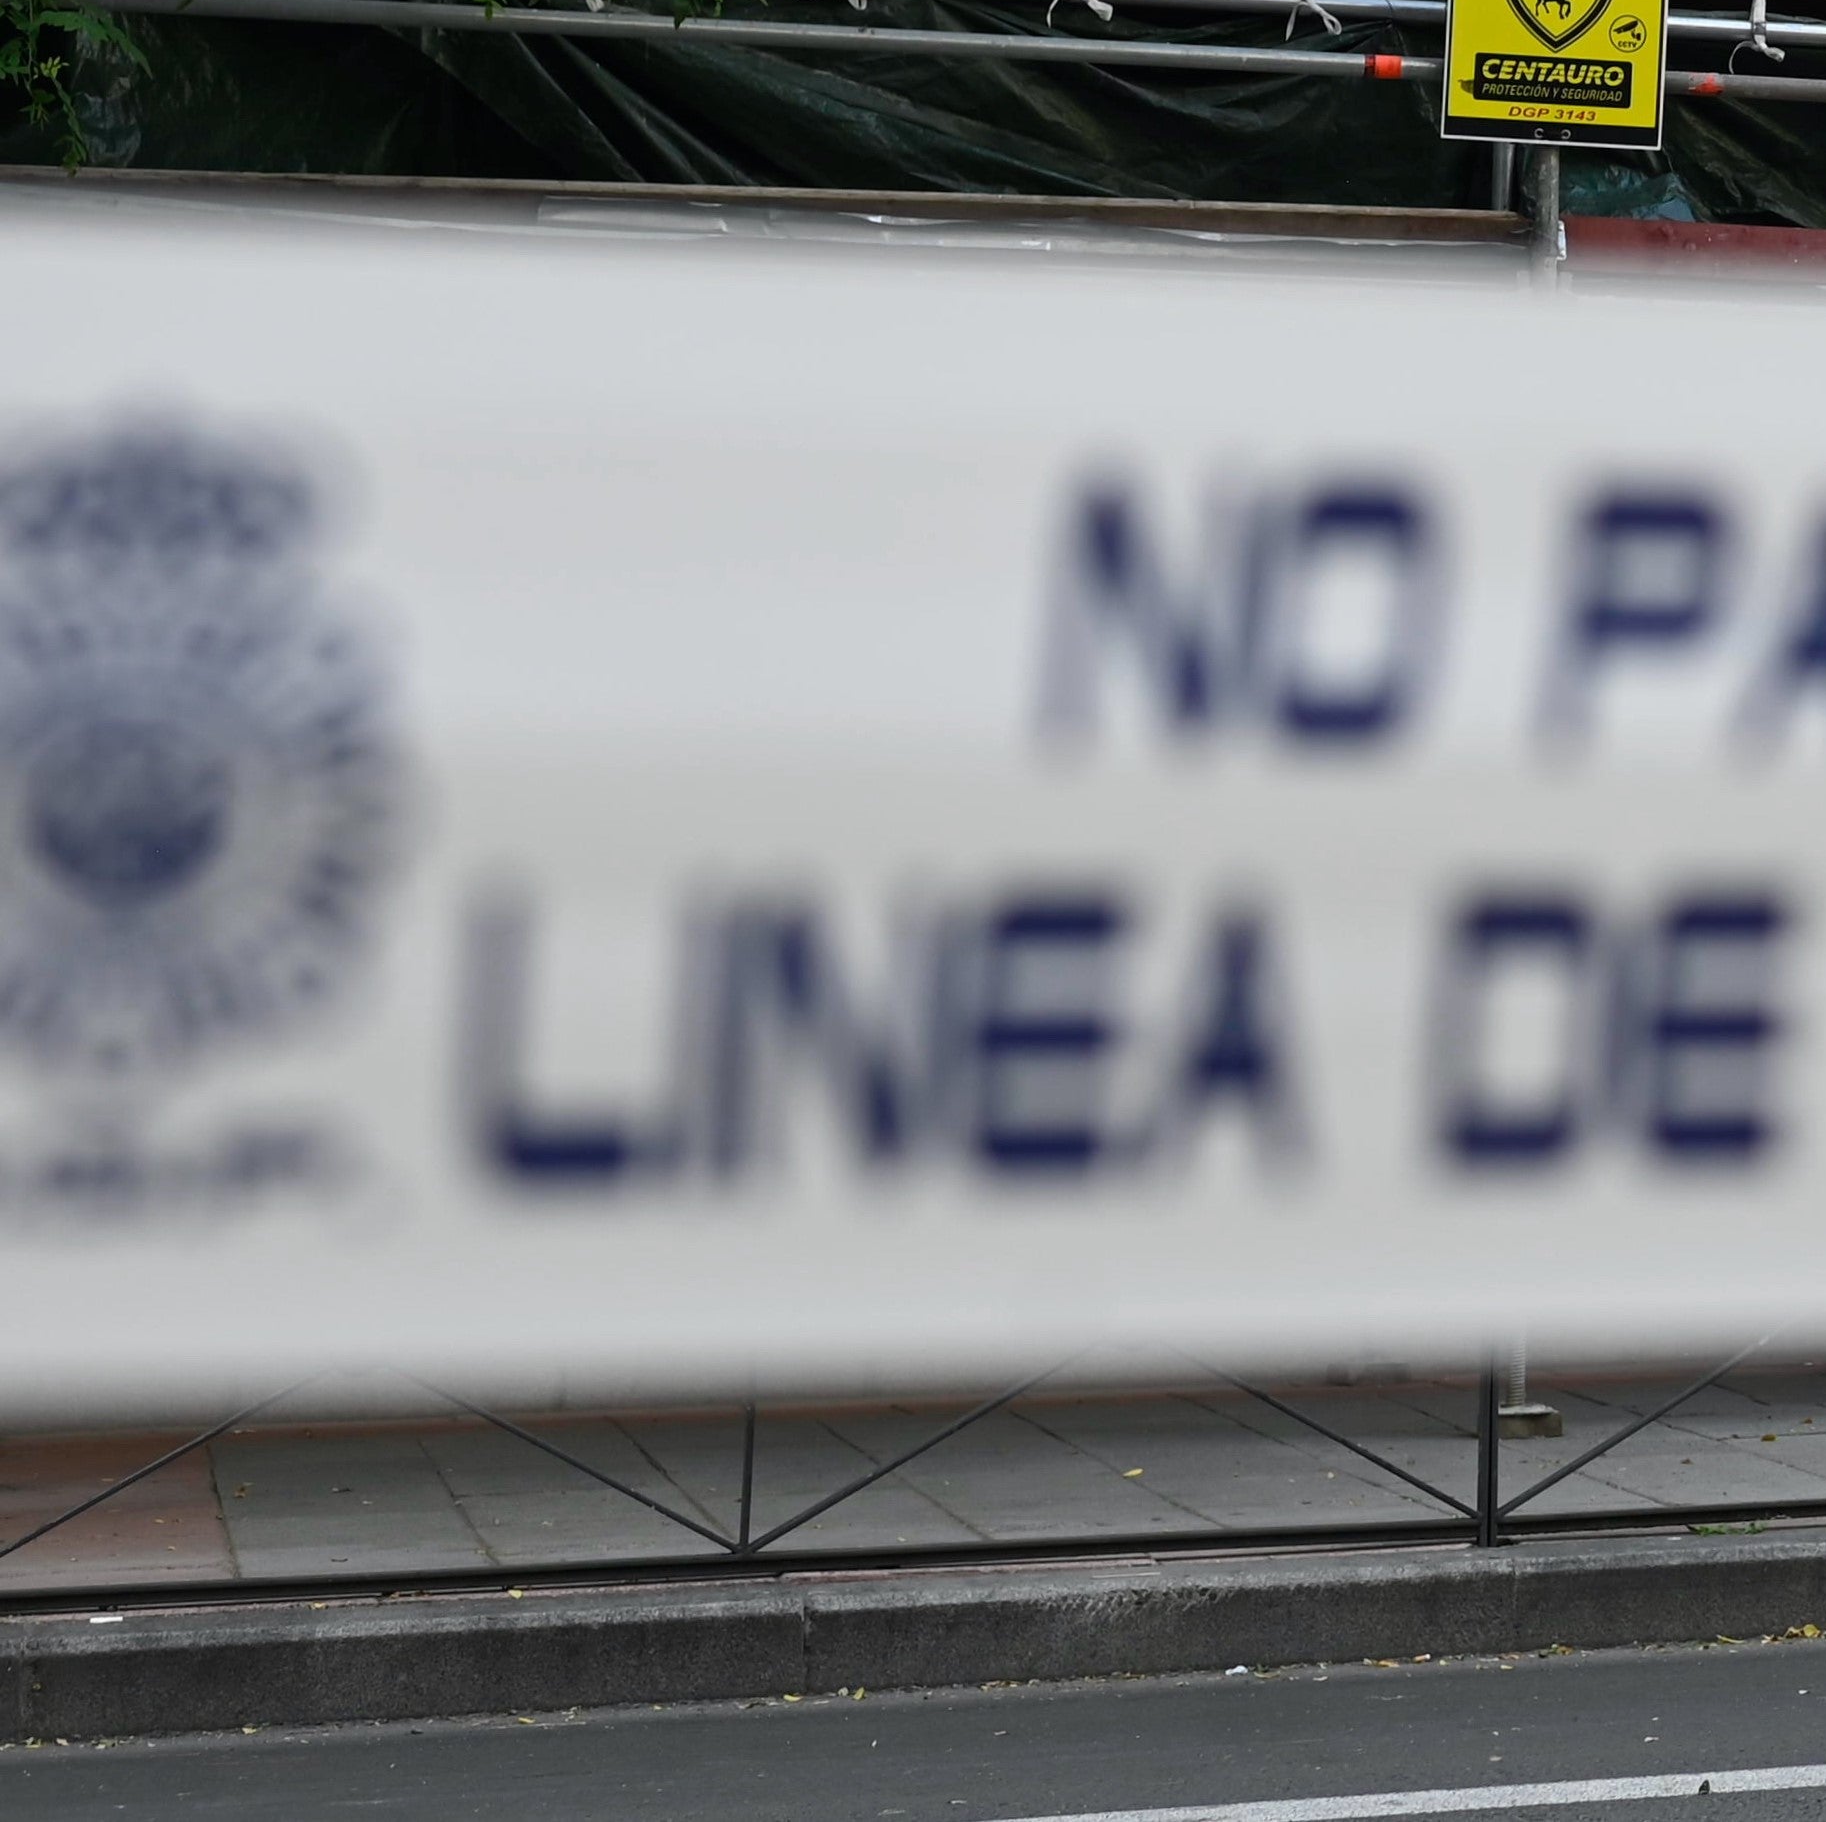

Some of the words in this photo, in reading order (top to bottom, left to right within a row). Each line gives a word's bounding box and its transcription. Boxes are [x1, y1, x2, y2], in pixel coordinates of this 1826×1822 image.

[1617, 41, 1638, 49] CCTV
[1482, 58, 1625, 86] CENTAURO
[1482, 82, 1550, 98] PROTECCIÓN
[1551, 88, 1560, 98] Y
[1560, 88, 1623, 102] SEGURIDAD
[1508, 106, 1550, 118] DGP
[1554, 109, 1597, 121] 3143
[1035, 466, 1445, 758] NO
[460, 878, 1310, 1188] LINEA
[1430, 883, 1805, 1178] DE
